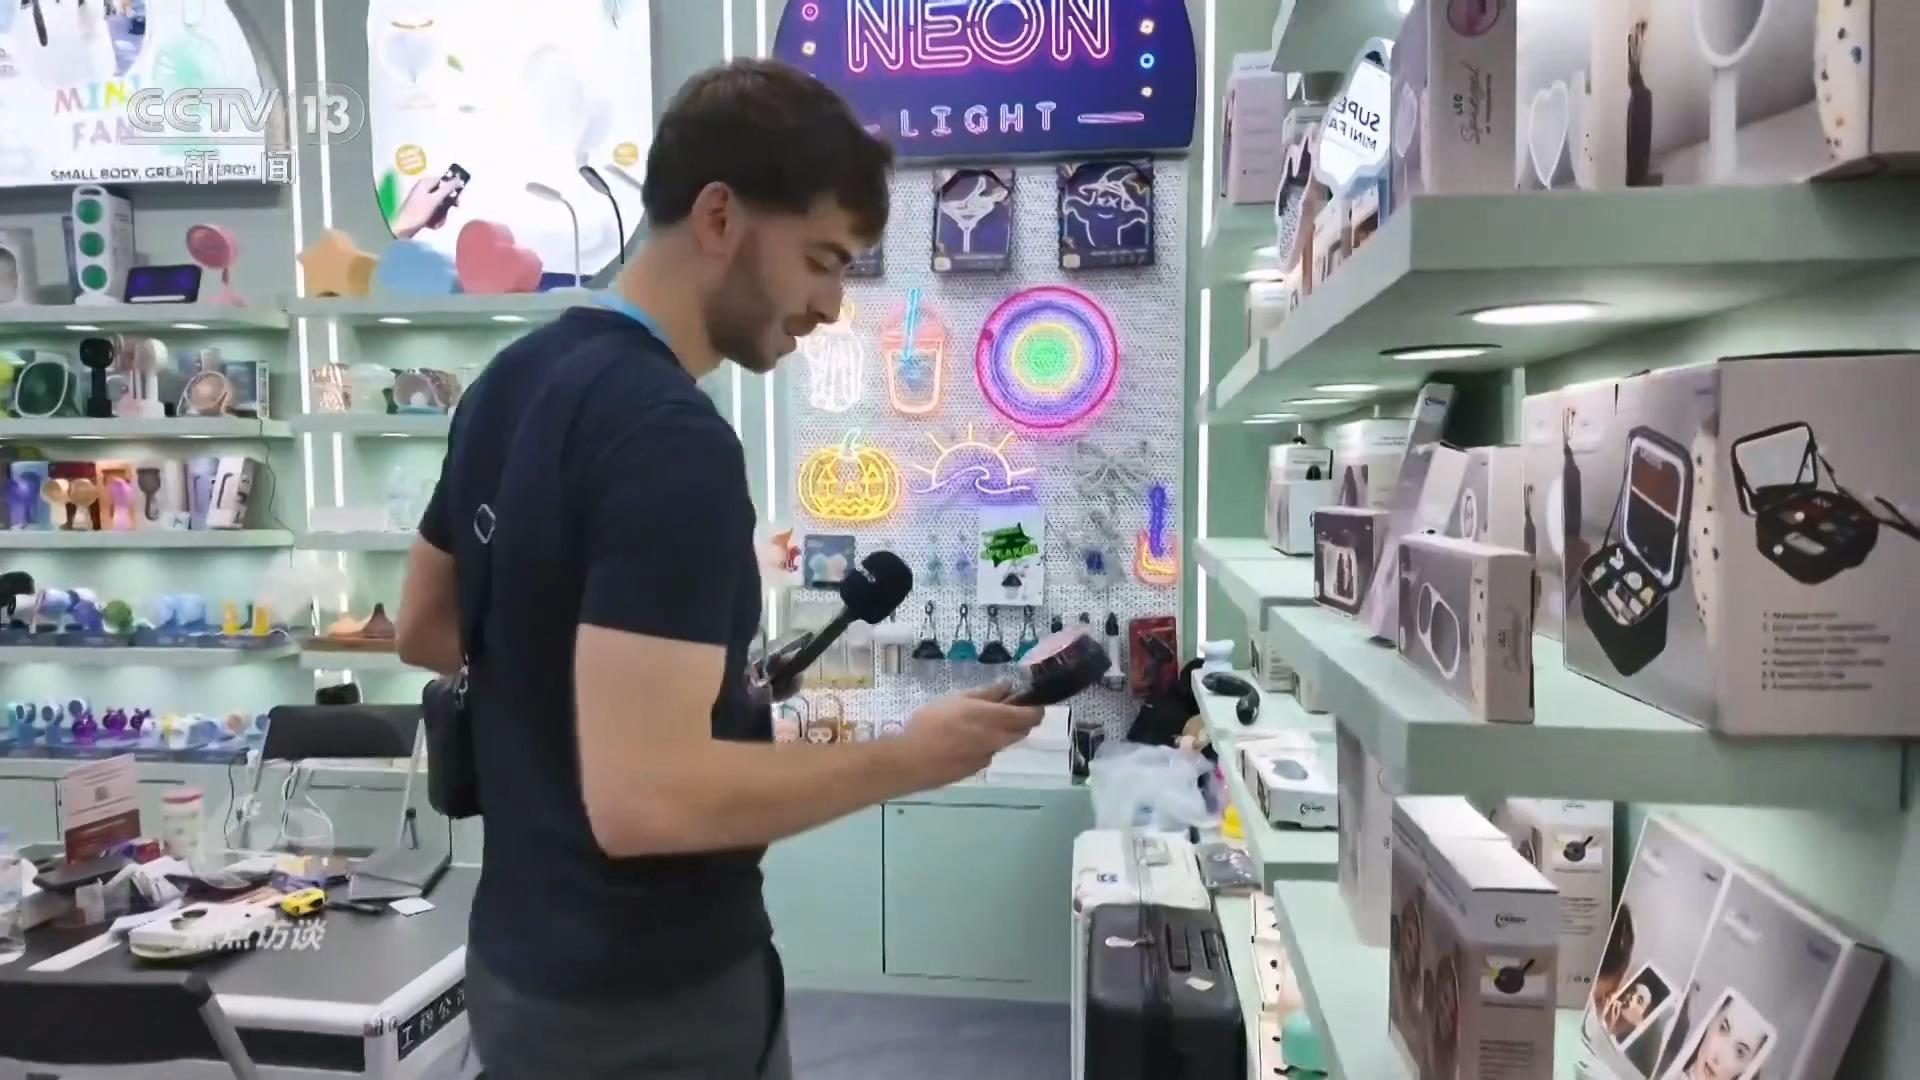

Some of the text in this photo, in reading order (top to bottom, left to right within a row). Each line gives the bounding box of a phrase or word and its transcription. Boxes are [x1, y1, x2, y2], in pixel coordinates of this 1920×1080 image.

[847, 0, 1110, 72] NEON
[900, 100, 1057, 137] LIGHT
[51, 168, 99, 181] SMALL
[101, 167, 141, 180] BODY,
